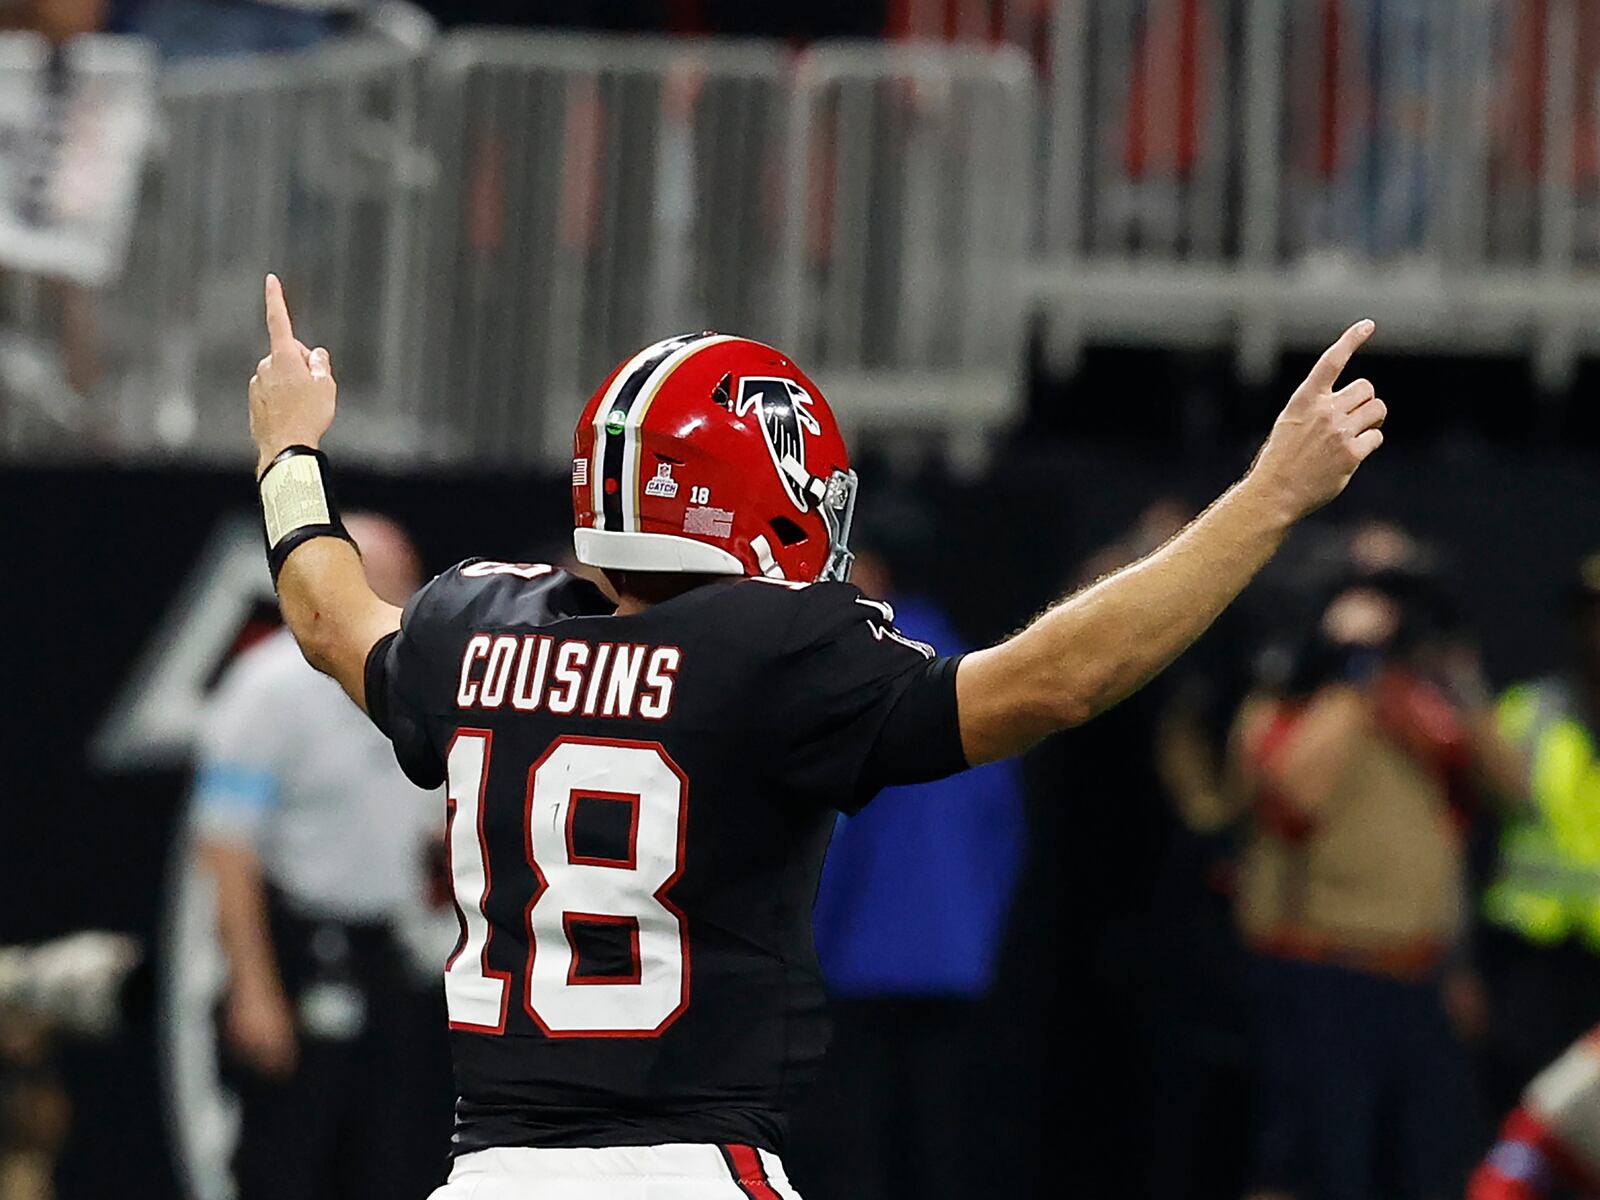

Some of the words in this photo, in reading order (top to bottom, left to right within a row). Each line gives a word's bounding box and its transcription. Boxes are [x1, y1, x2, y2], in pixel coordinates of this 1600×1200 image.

[648, 482, 677, 493] CATCH
[690, 486, 709, 504] 18
[456, 633, 682, 720] COUSINS
[445, 728, 690, 1039] 18
